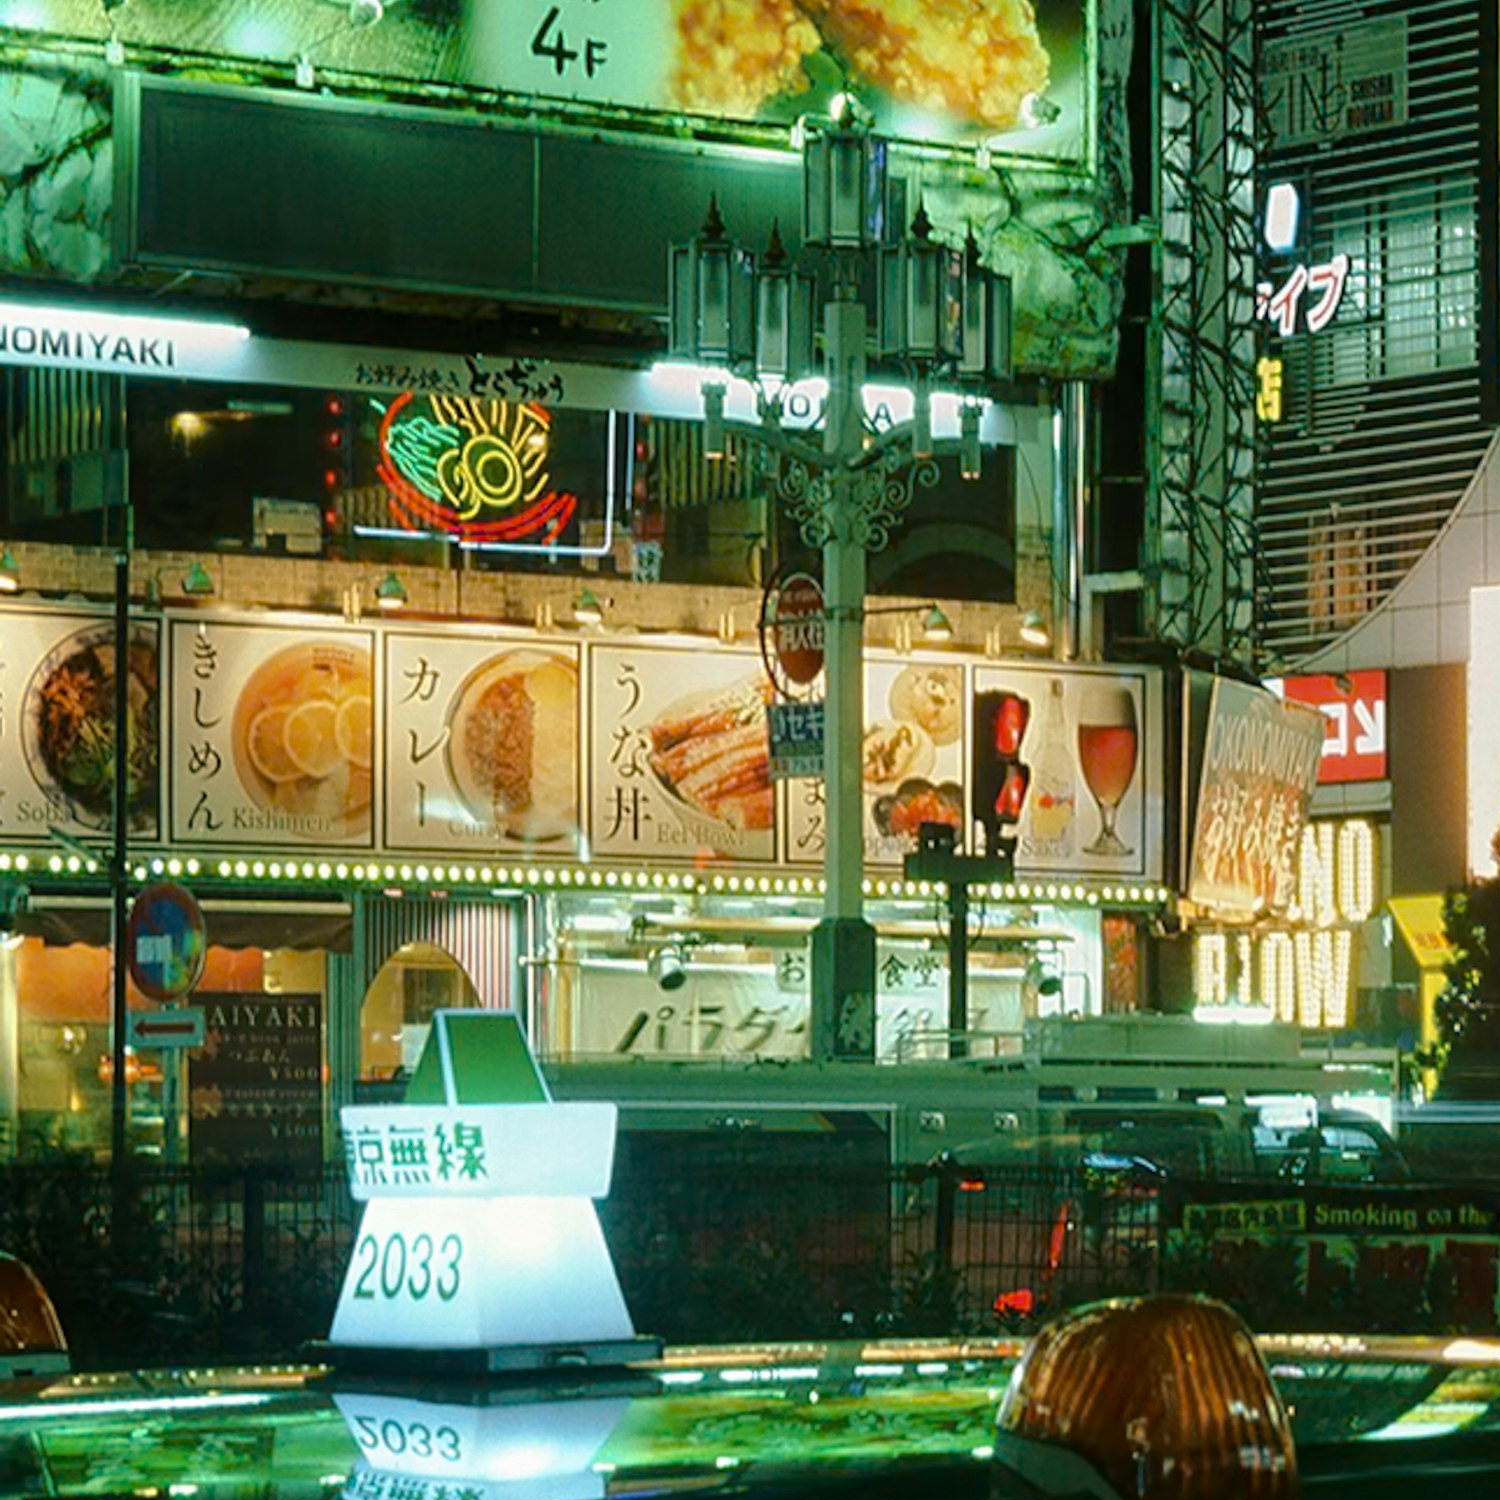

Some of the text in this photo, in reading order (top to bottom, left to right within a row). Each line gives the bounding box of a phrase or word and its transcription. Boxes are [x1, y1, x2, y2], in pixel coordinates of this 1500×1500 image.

[531, 6, 607, 79] 4F
[186, 628, 224, 832] きしめん
[400, 657, 448, 827] カレー
[209, 1005, 317, 1029] AIYAKI
[616, 1004, 788, 1052] パラダ
[1313, 1202, 1418, 1231] Smoking
[1426, 1209, 1451, 1228] on
[353, 1233, 463, 1301] 2033
